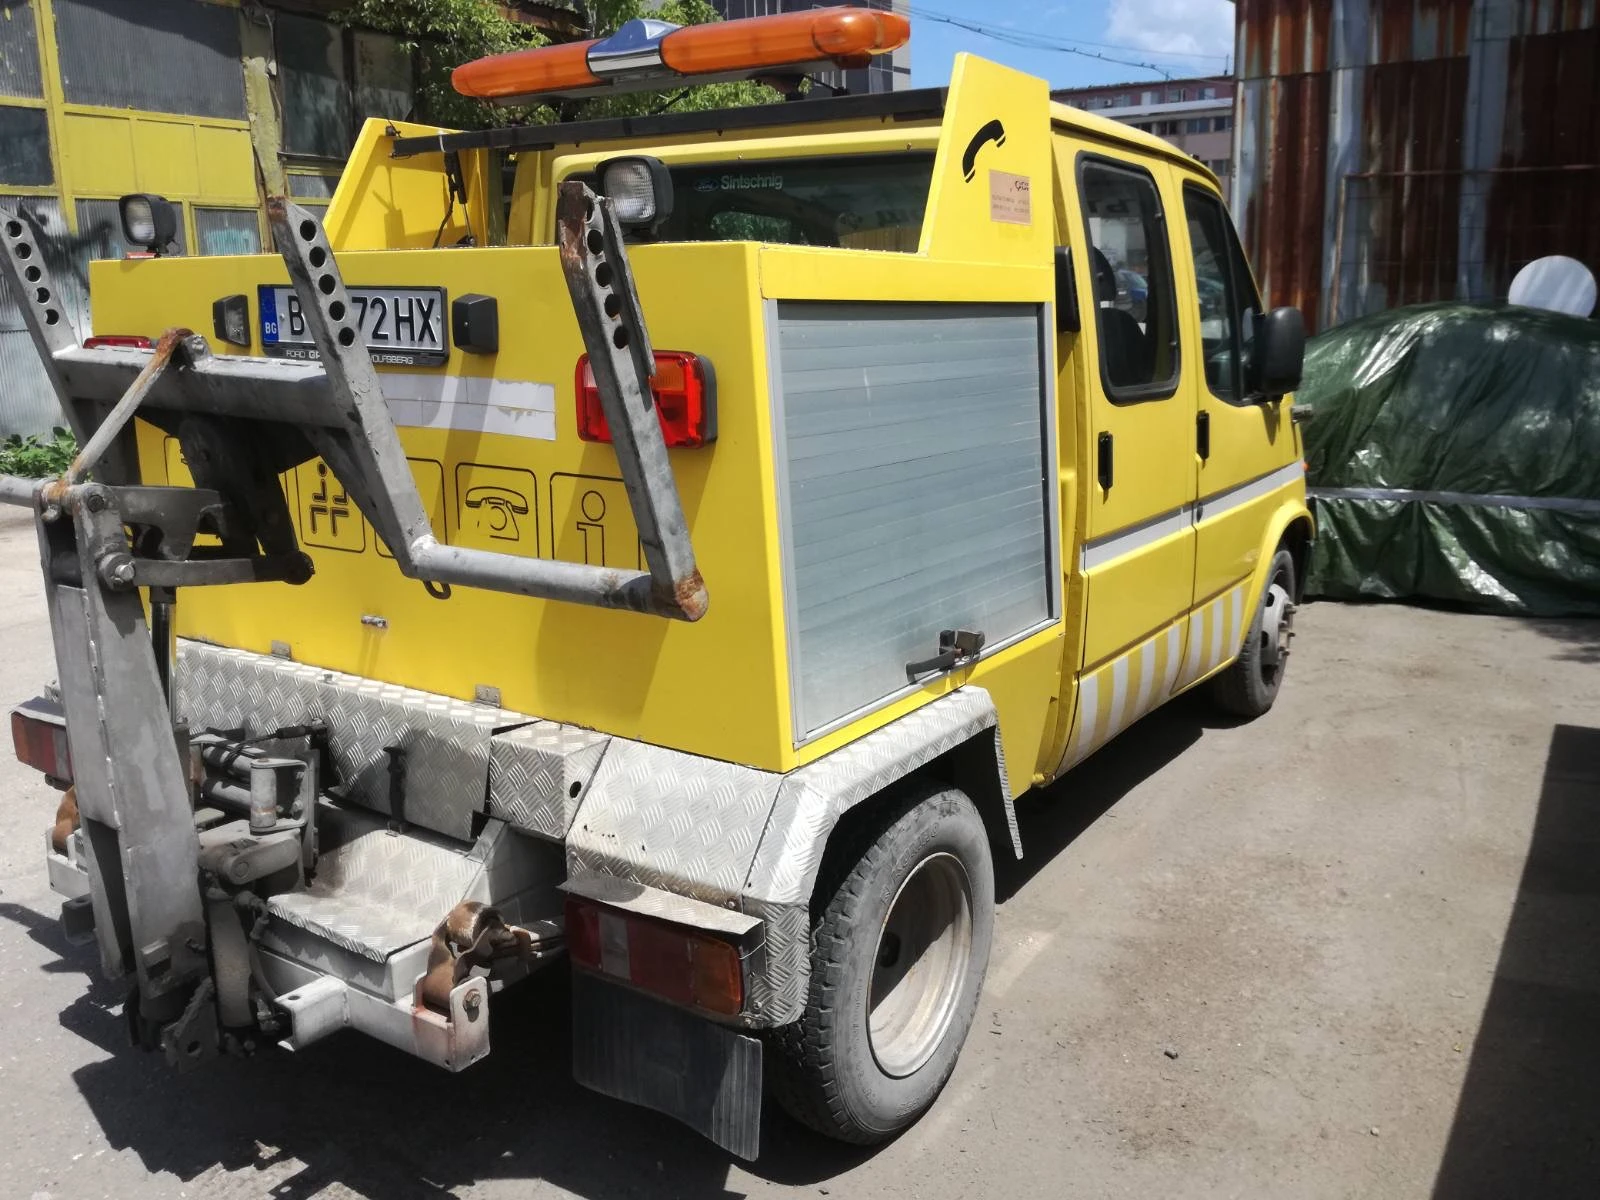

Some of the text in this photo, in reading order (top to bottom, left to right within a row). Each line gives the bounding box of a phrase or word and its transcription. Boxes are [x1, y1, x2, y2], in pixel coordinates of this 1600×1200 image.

[720, 173, 783, 190] Sintschnig
[264, 321, 277, 335] BG
[371, 354, 413, 365] OLFSBERG
